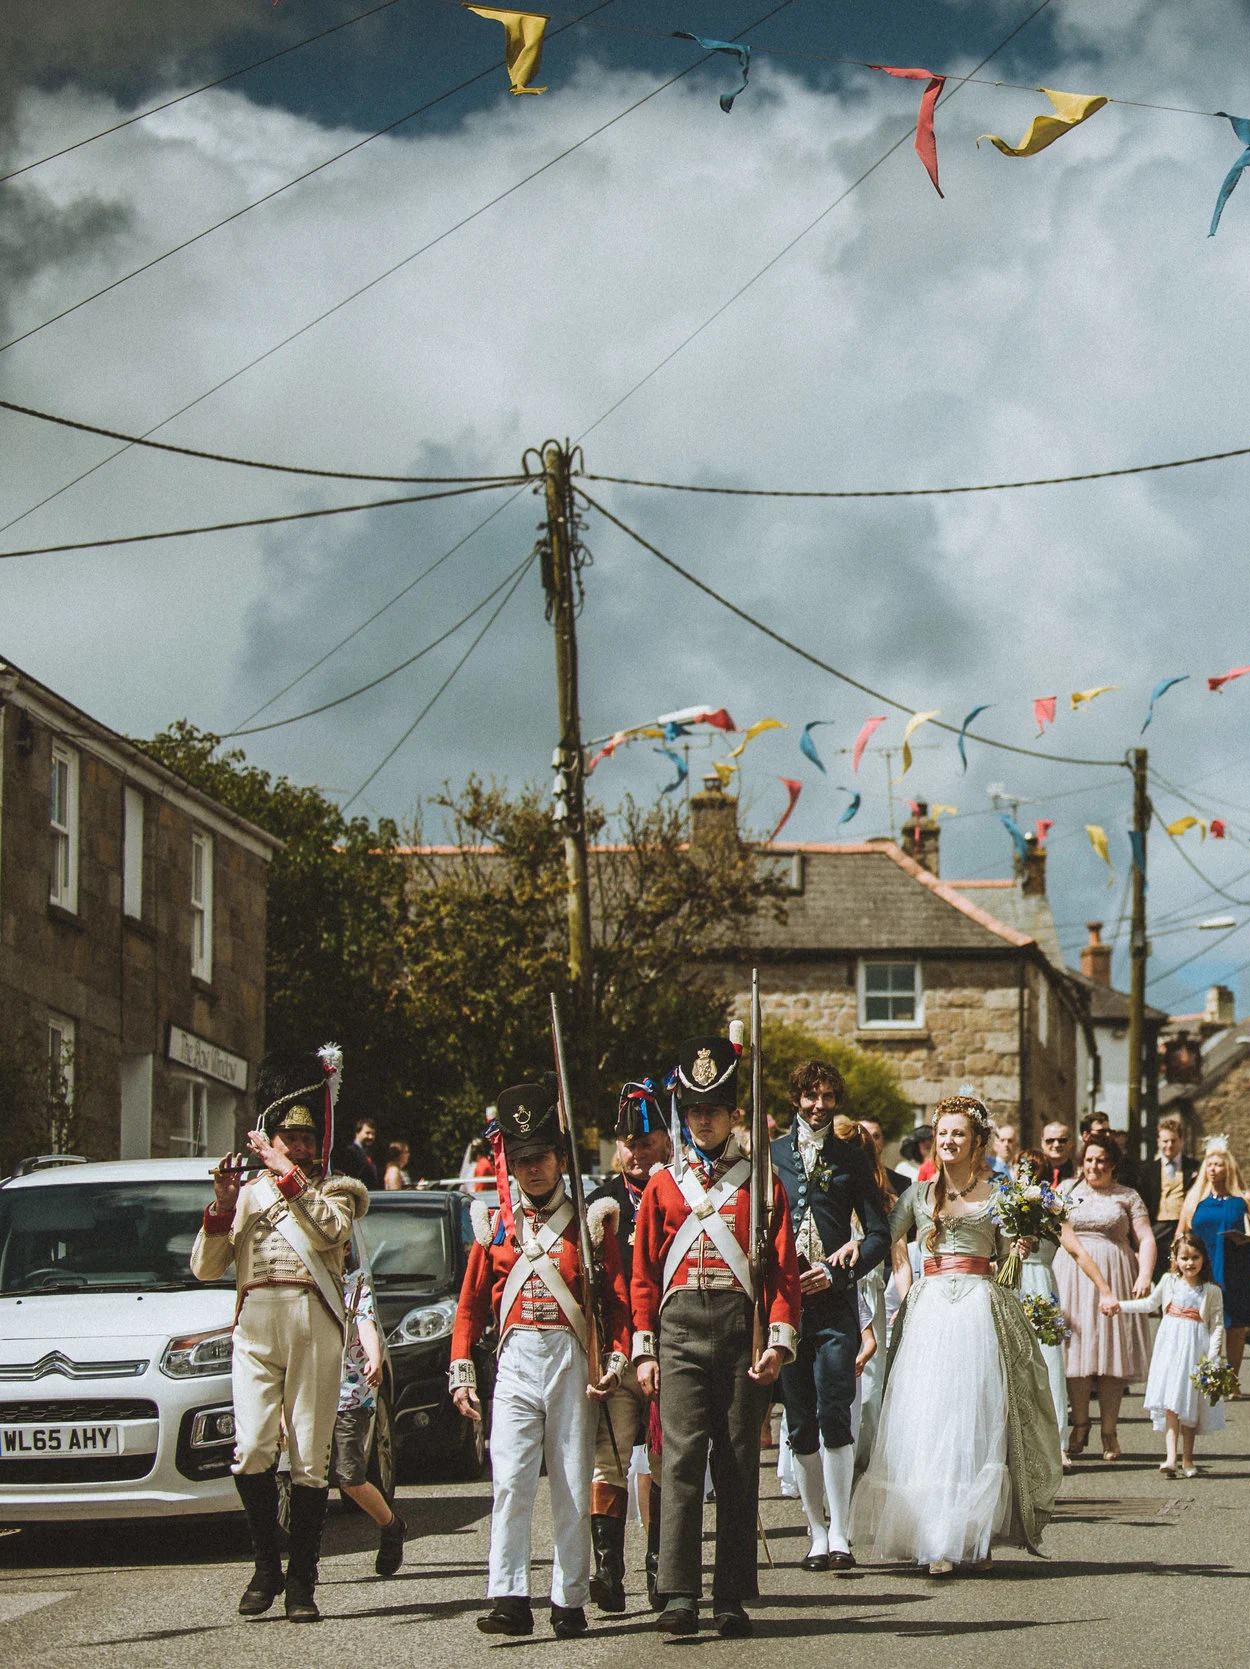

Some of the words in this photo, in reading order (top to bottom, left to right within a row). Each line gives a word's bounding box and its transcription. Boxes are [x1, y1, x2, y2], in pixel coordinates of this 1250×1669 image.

[520, 1124, 531, 1133] 32
[4, 1429, 61, 1451] WL65
[69, 1427, 112, 1449] AHY
